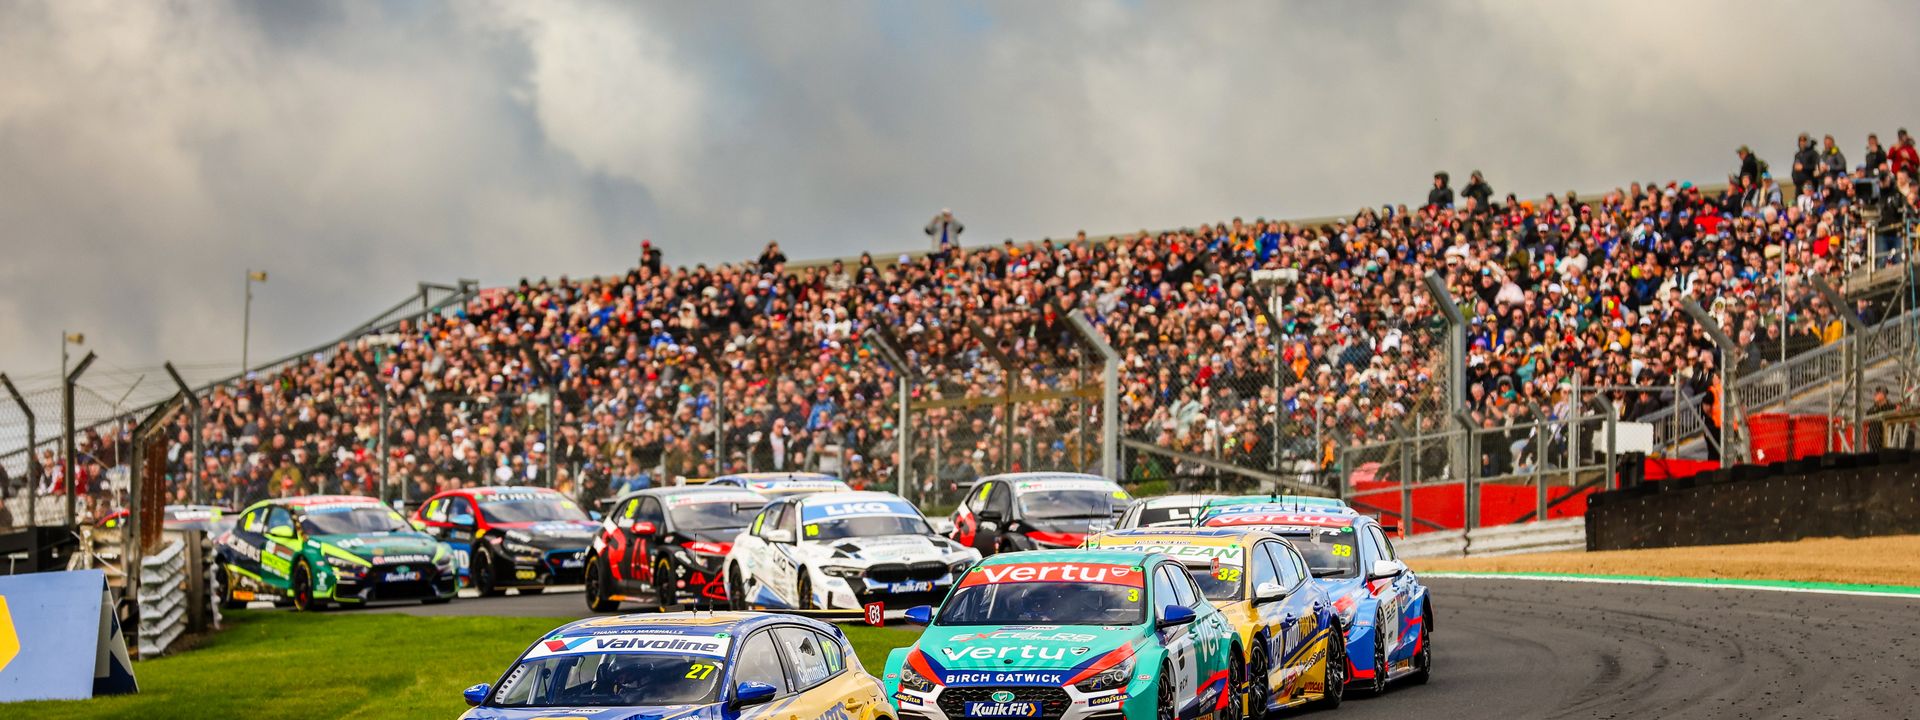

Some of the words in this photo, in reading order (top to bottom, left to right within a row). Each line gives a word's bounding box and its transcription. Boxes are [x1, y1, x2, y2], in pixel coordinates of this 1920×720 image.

[825, 502, 890, 515] LKQ
[1215, 514, 1329, 524] vertu
[1332, 543, 1352, 557] 33
[983, 564, 1107, 583] vertu
[1217, 567, 1241, 582] 32
[890, 581, 929, 594] KwikFit
[1127, 588, 1139, 603] 3
[596, 637, 720, 653] Valvoline
[821, 640, 840, 672] 27
[946, 645, 1066, 661] vertu
[684, 663, 715, 681] 27
[945, 673, 991, 684] BIRCH
[995, 673, 1061, 684] GATWICK
[895, 693, 922, 704] GOODYEAR
[1092, 694, 1128, 705] GOODYEAR
[971, 702, 1029, 716] KwikFit
